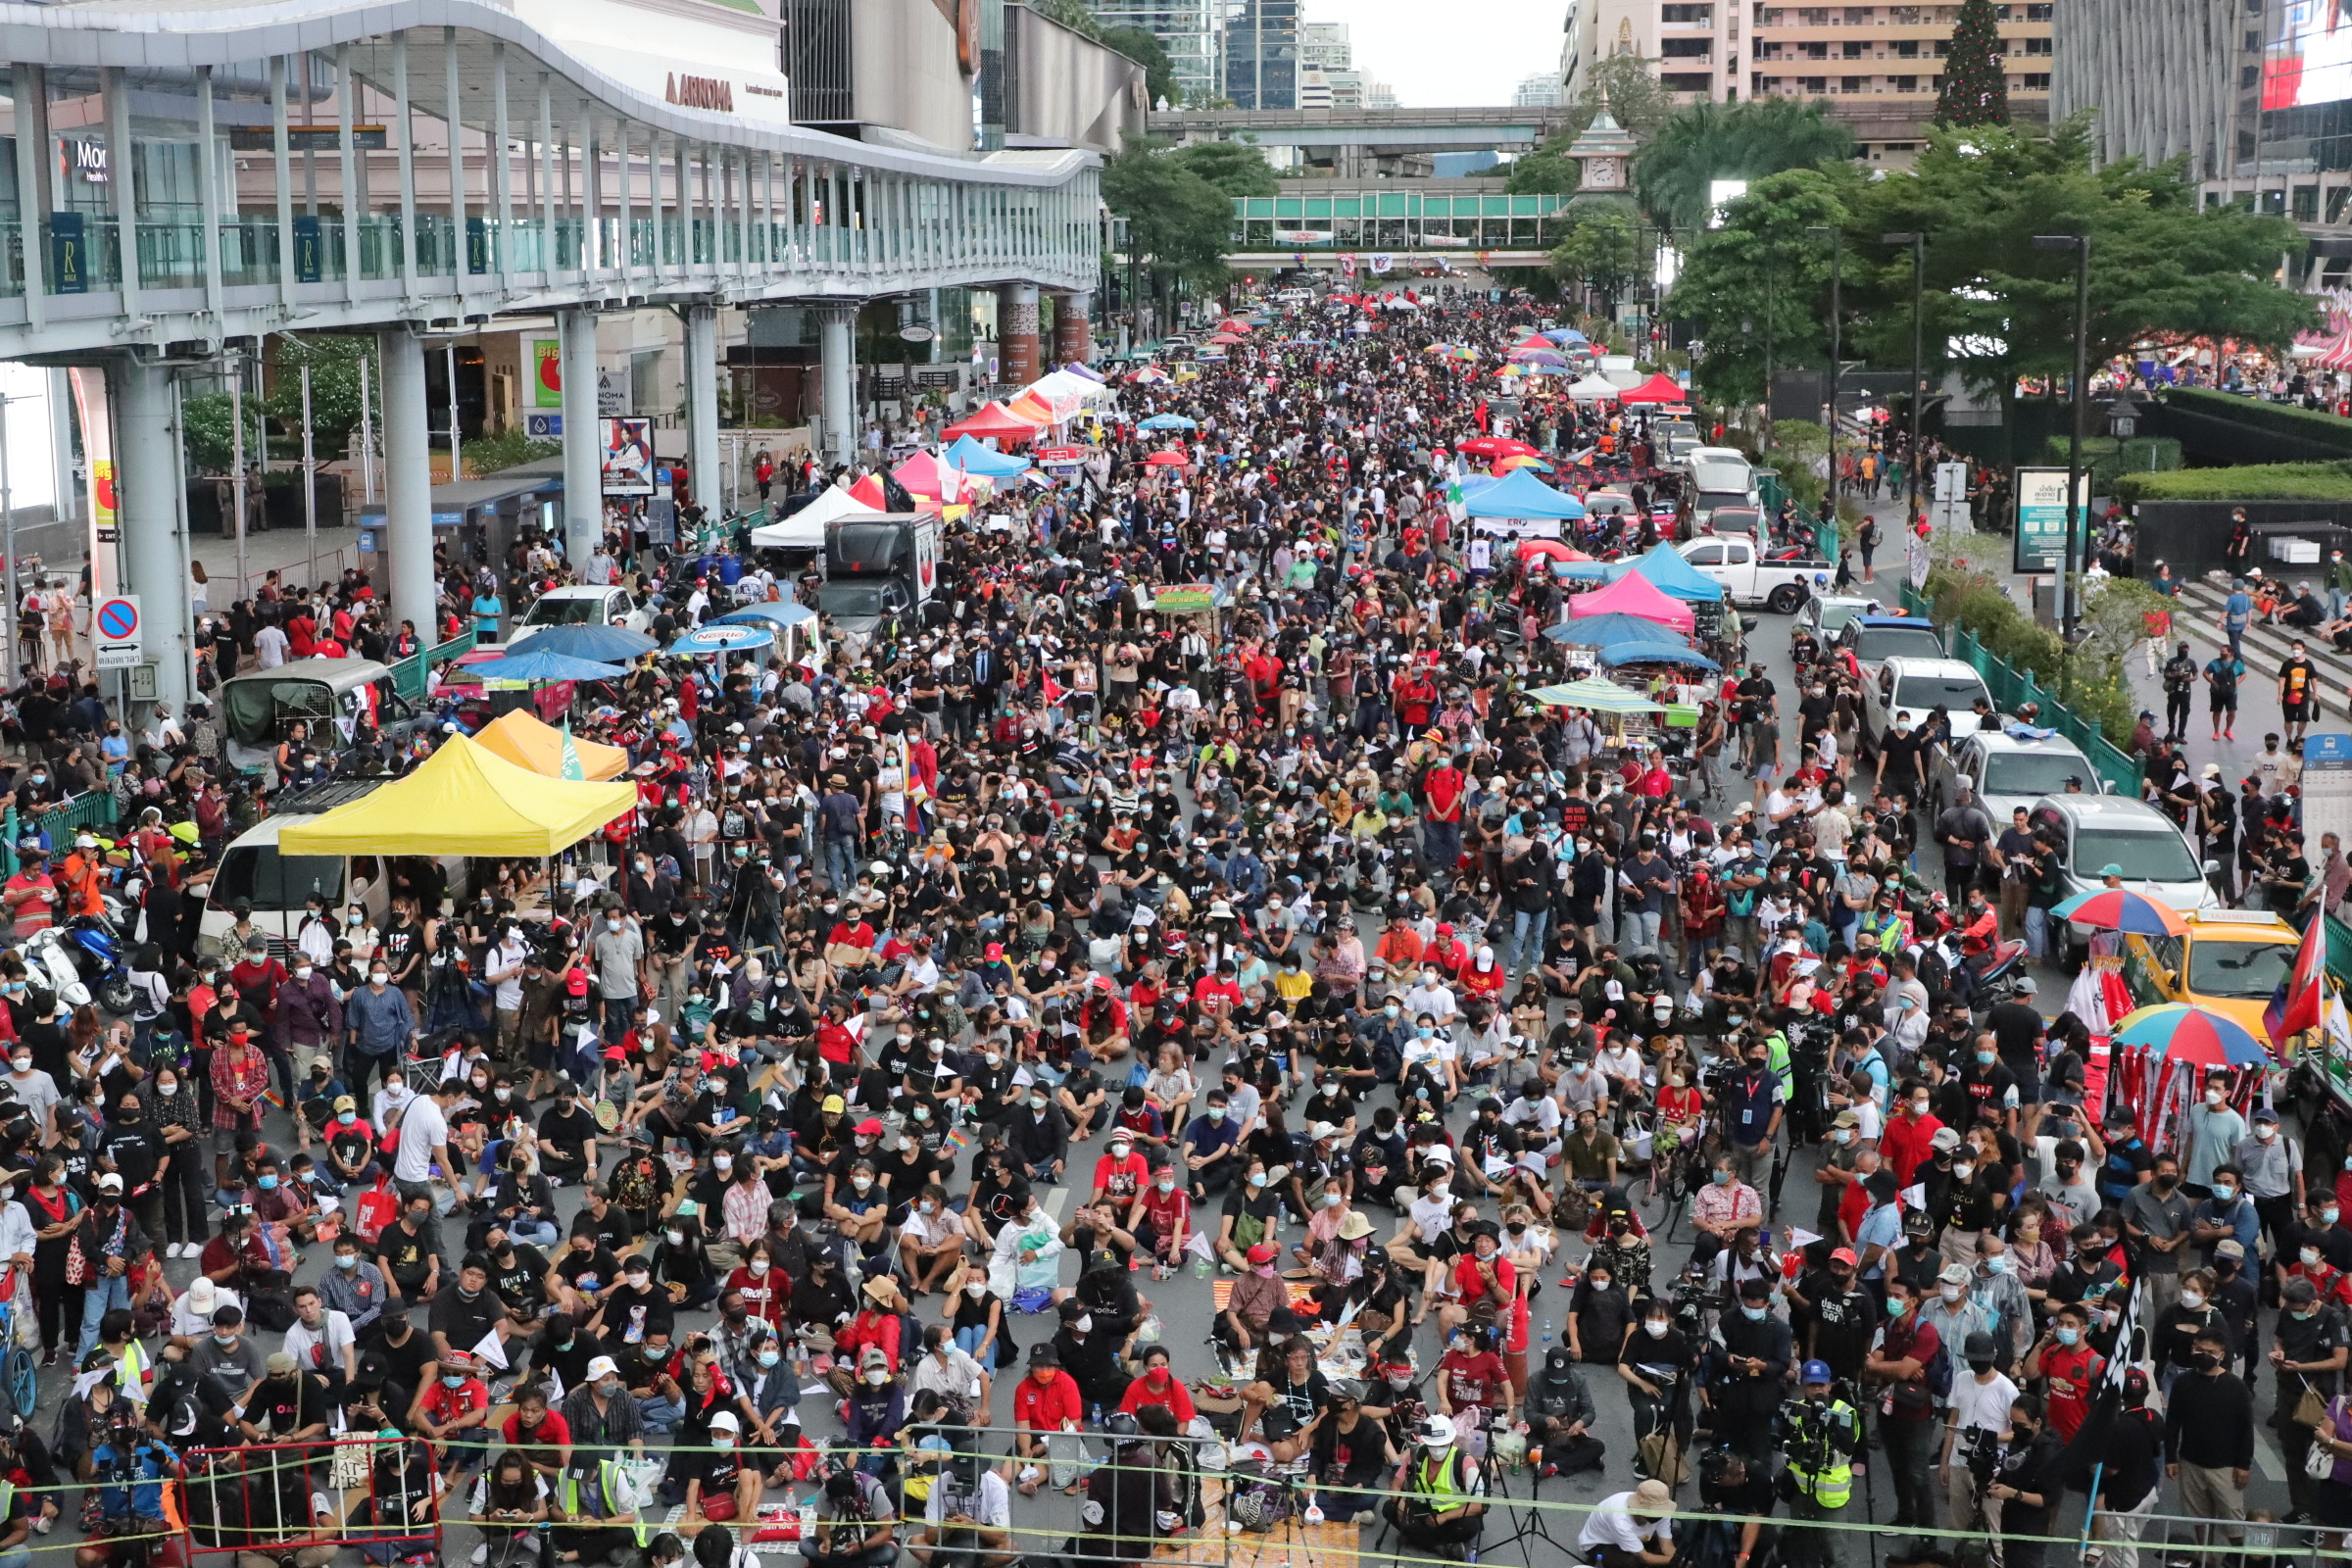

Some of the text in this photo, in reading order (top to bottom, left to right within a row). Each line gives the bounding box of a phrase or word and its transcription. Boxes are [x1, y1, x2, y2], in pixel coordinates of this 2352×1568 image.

[678, 74, 734, 112] ARNOMA
[65, 241, 76, 273] R
[305, 239, 314, 267] R
[98, 655, 140, 665] ตลอดเวลา
